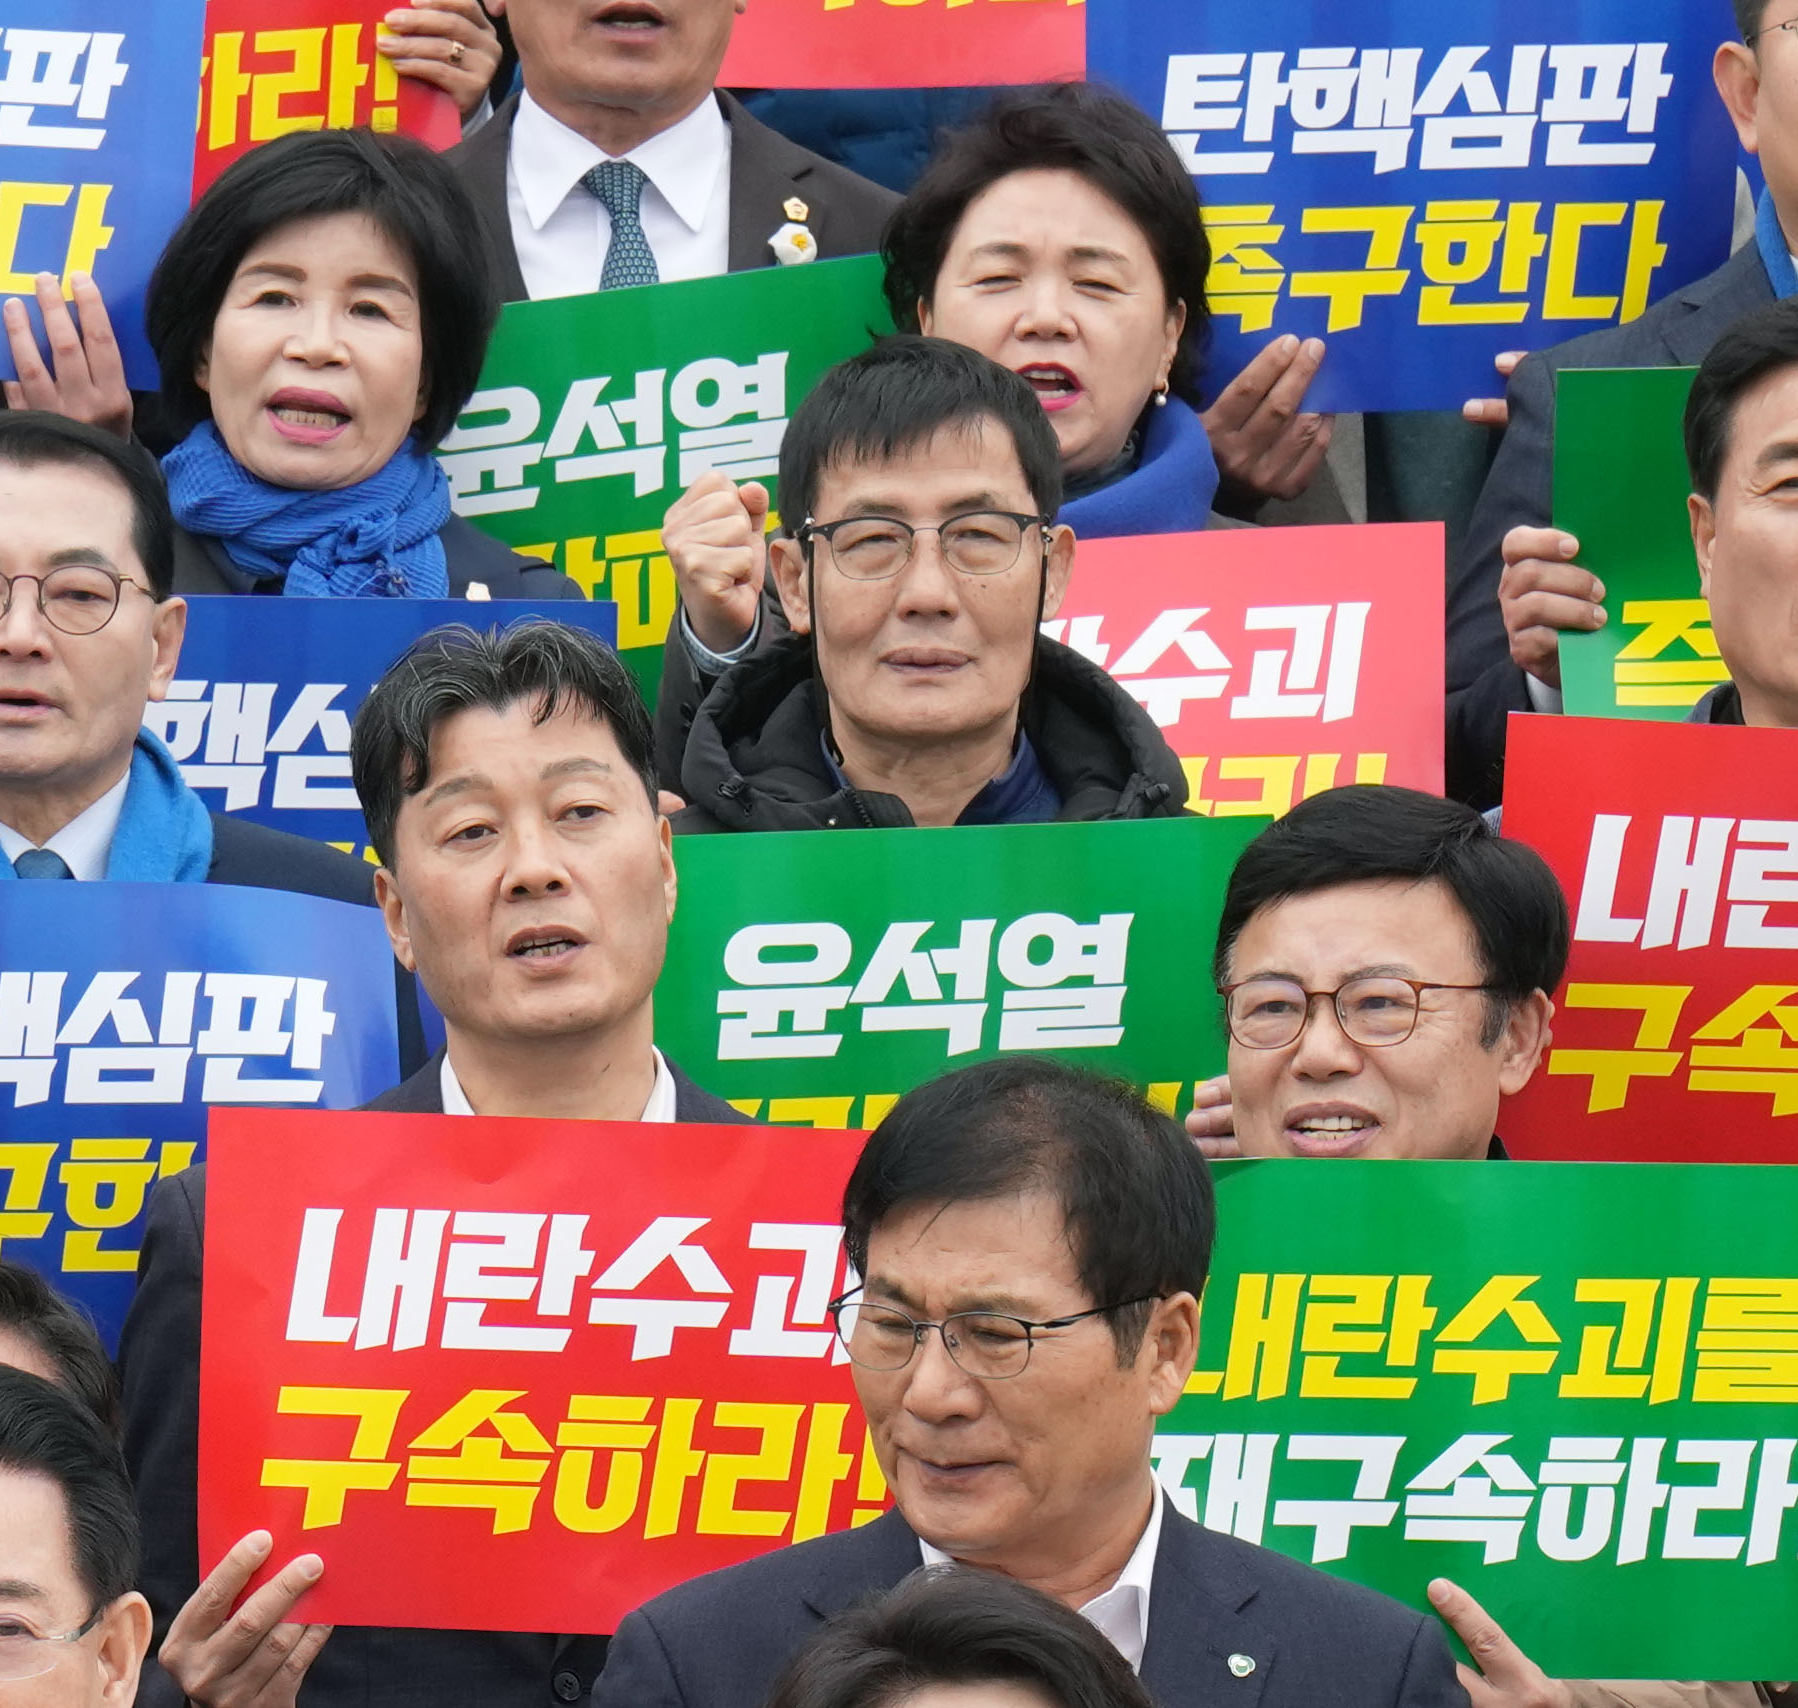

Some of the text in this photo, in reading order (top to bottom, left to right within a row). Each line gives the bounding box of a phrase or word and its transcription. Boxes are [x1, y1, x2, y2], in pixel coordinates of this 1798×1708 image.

[1160, 43, 1674, 175] 탄핵심판
[436, 351, 790, 517] 윤석열
[716, 911, 1134, 1060] 윤석열
